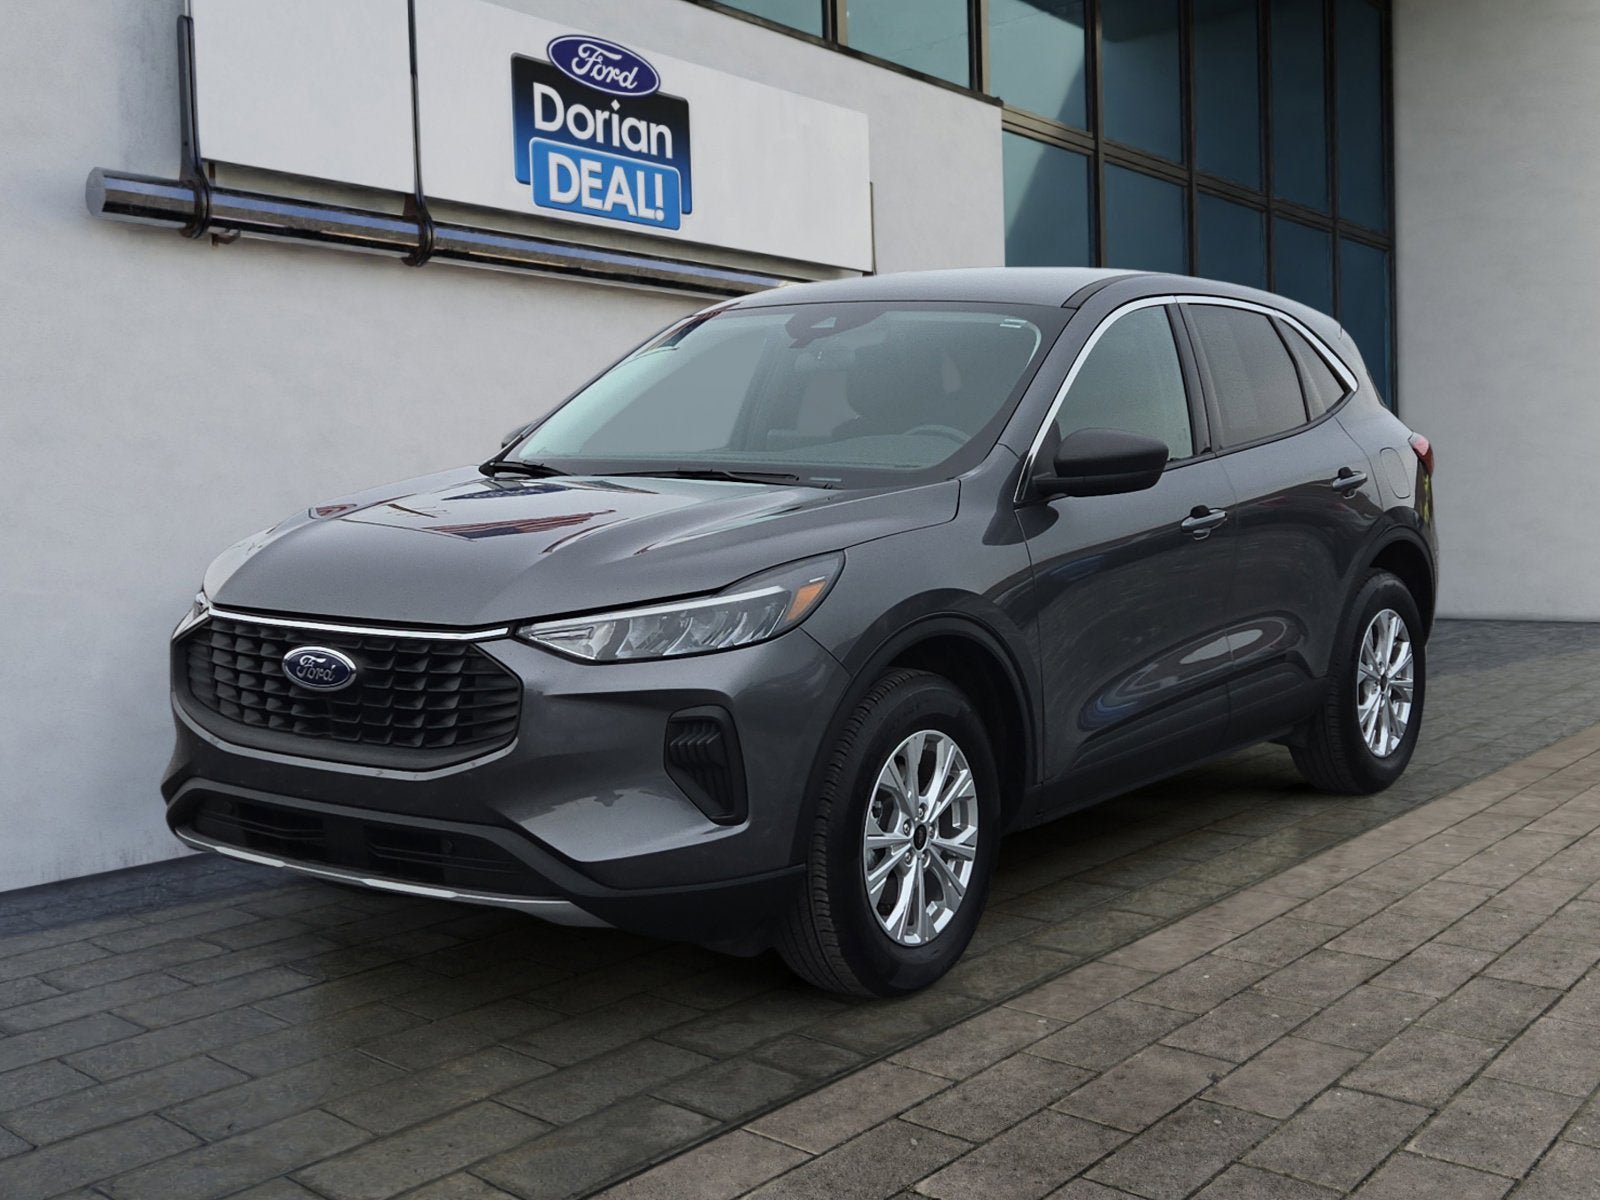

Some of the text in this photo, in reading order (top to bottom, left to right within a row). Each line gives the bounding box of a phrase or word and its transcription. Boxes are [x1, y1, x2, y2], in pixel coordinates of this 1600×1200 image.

[571, 43, 639, 89] Ford
[533, 82, 673, 159] Dorian
[549, 151, 665, 222] DEAL!
[296, 655, 336, 681] Ford
